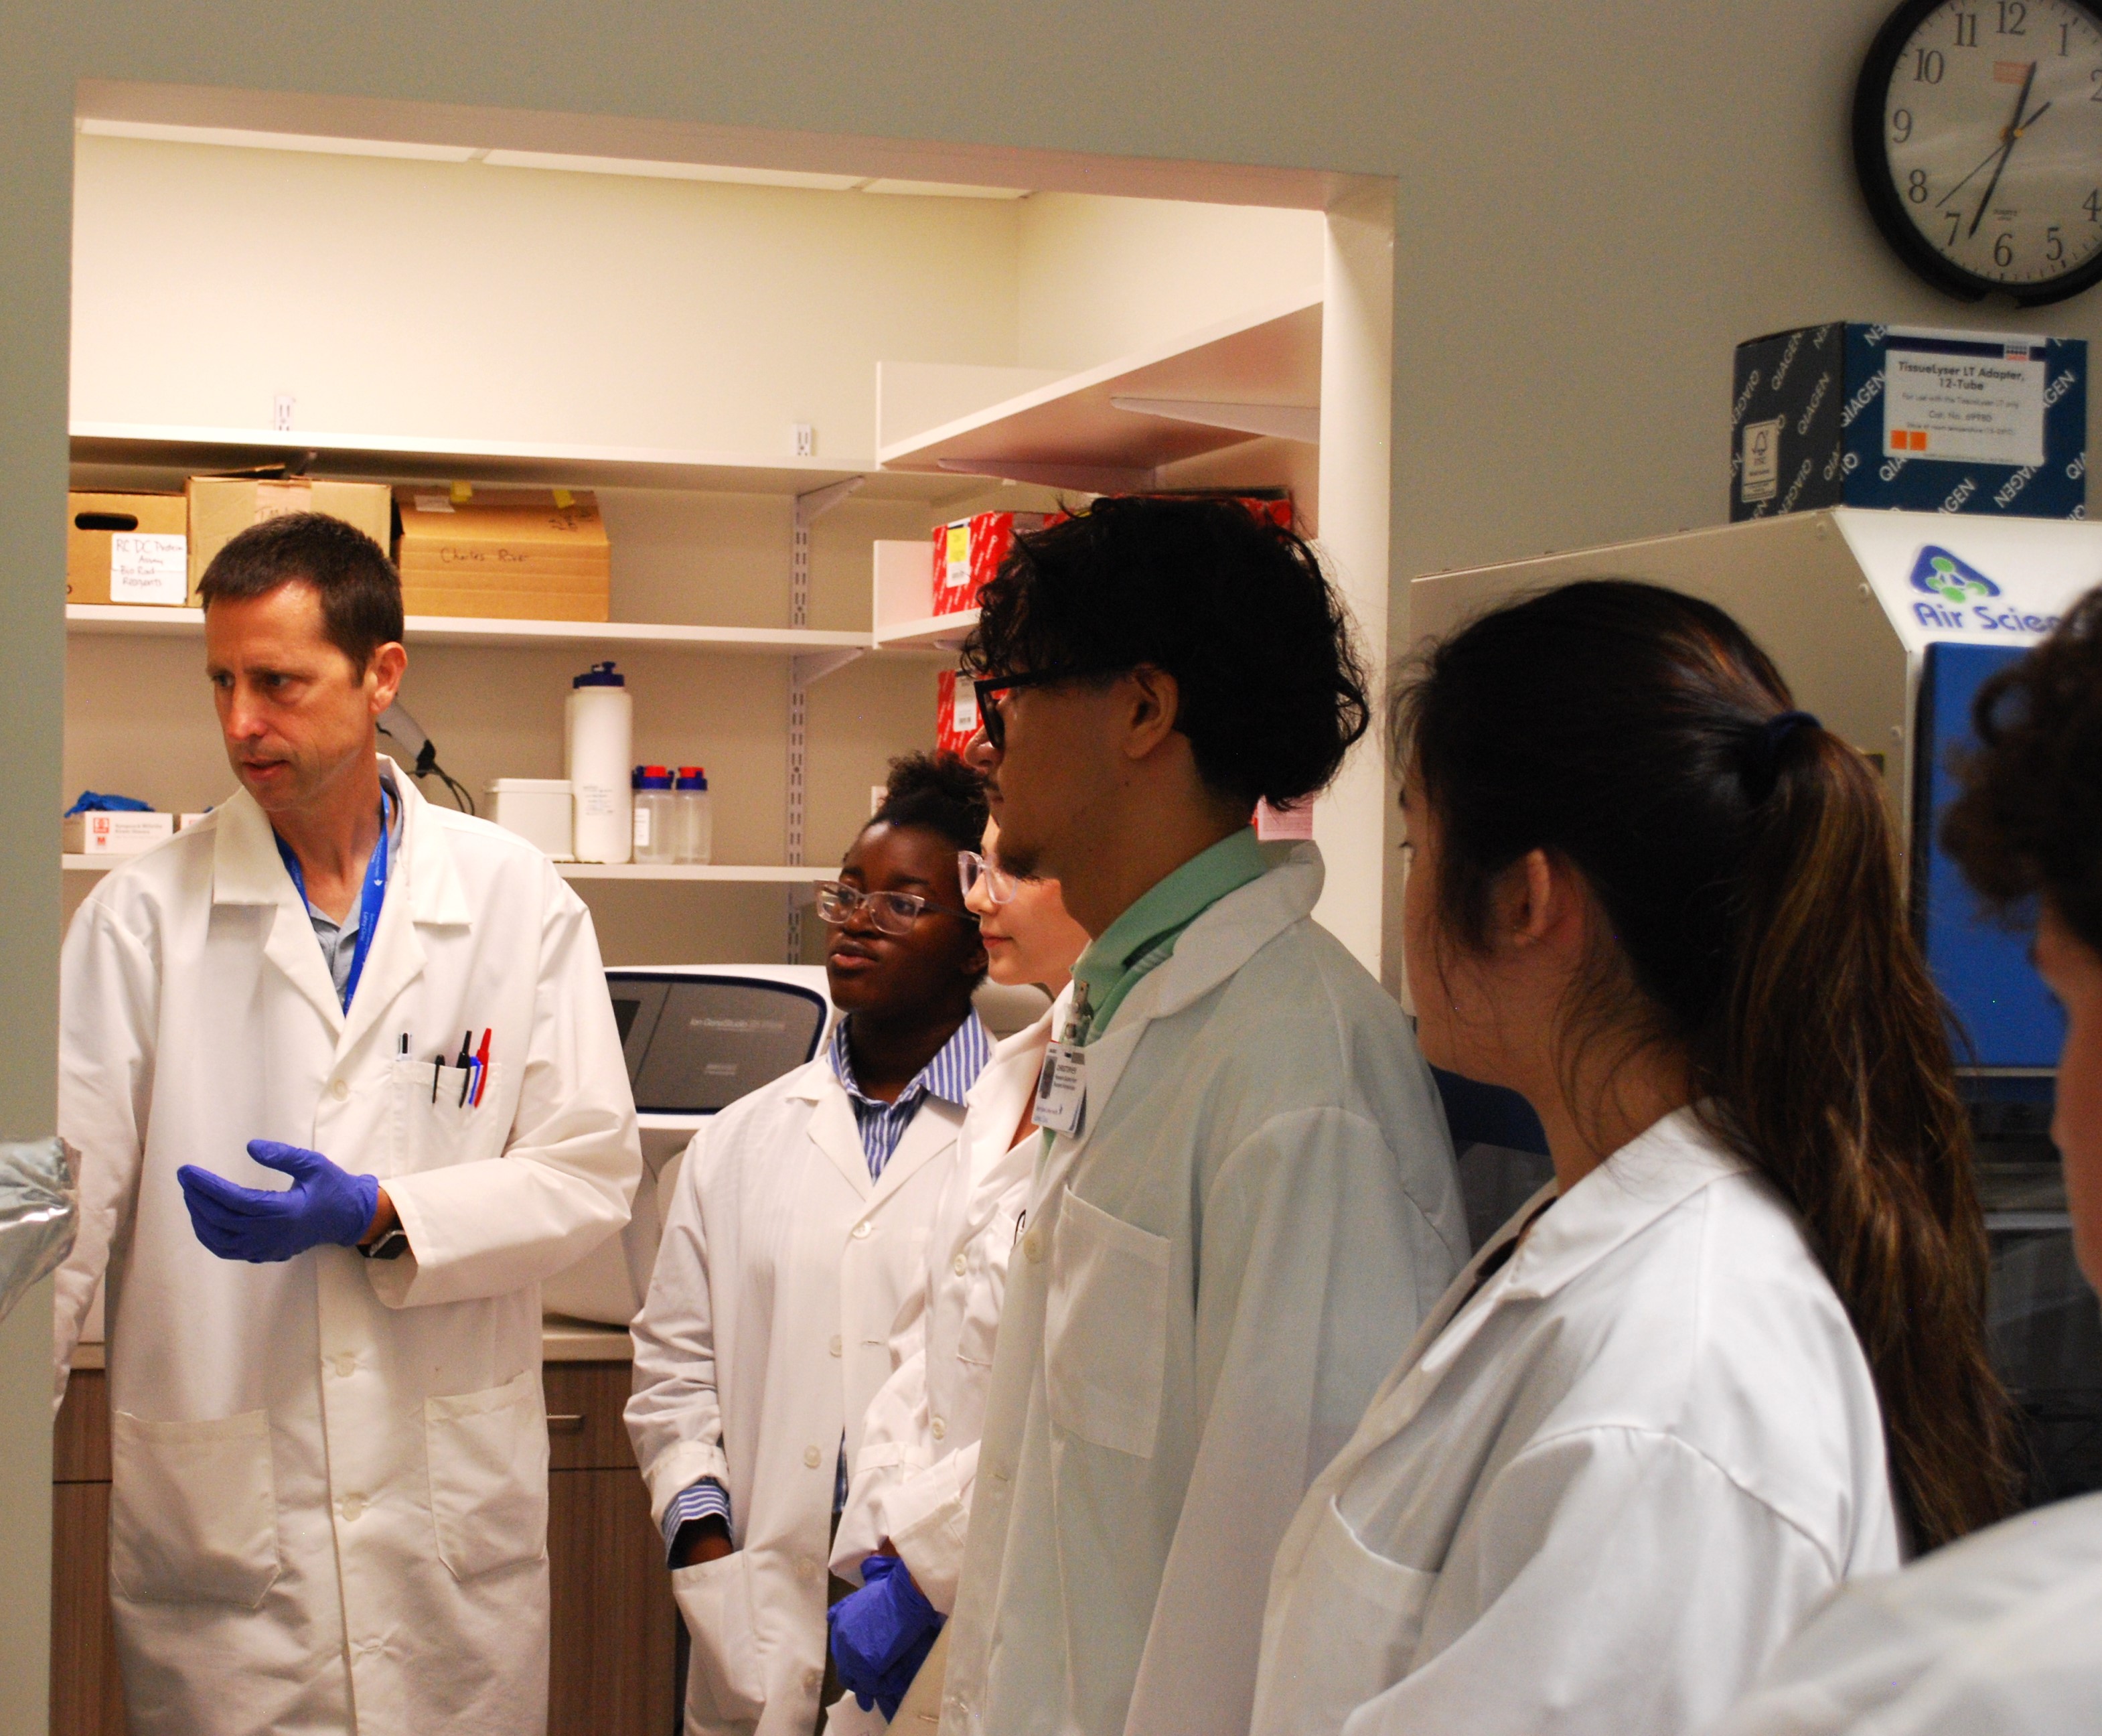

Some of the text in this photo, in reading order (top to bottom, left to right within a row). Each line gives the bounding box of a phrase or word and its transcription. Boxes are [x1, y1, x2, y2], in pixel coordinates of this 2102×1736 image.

[1954, 12, 1977, 48] 11
[1996, 0, 2026, 35] 12
[2058, 23, 2070, 57] 1
[1913, 48, 1945, 84] 10
[2090, 69, 2102, 102] 2
[1892, 109, 1912, 143] 9
[1908, 169, 1928, 204] 8
[2083, 188, 2101, 222] 4
[1945, 212, 1961, 246] 7
[2046, 227, 2062, 261] 5
[1994, 234, 2012, 267] 6
[1898, 361, 2024, 382] TissueLyser LT Adapter,
[1939, 378, 1984, 390] 12-Tube
[2043, 370, 2075, 407] GEN
[1797, 372, 1830, 435] QIAGEN
[1913, 602, 1963, 628] Air
